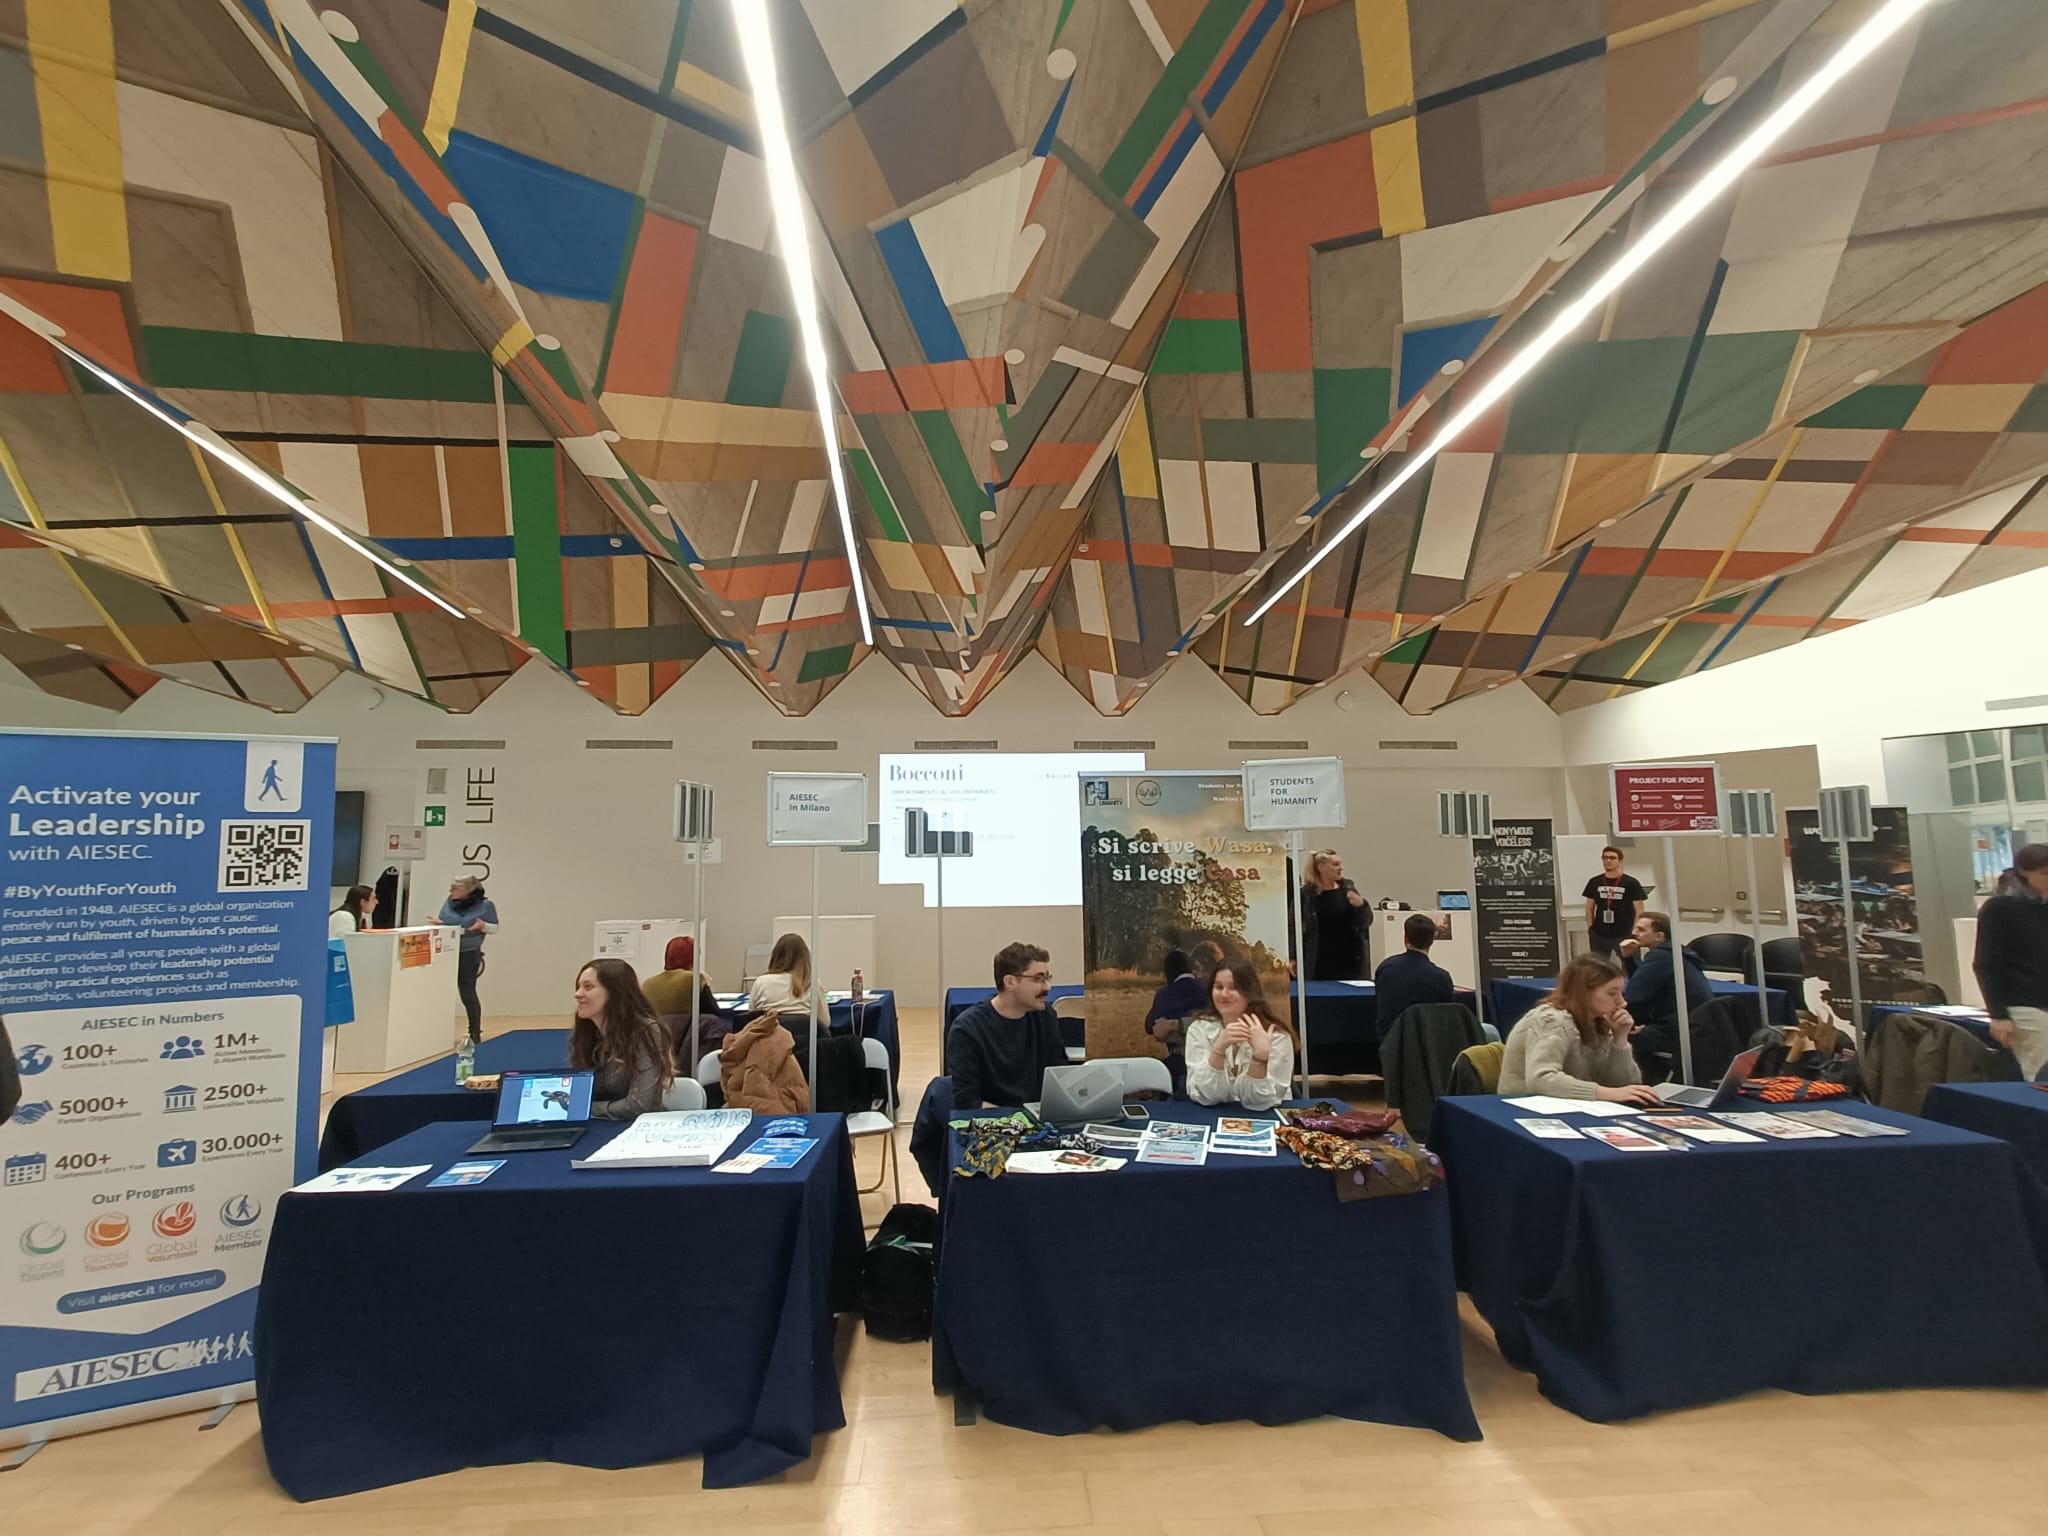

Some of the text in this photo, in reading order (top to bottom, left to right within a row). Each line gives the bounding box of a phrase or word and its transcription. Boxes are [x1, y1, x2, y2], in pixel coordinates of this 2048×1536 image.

[890, 764, 963, 781] Bocconi
[1270, 777, 1314, 786] STUDENTS
[9, 785, 201, 808] Activate your
[465, 767, 495, 823] LIFE
[1271, 797, 1318, 805] HUMANITY
[800, 803, 830, 812] Milano
[9, 812, 205, 839] Leadership
[8, 844, 153, 861] with AIESEC.
[1098, 837, 1122, 854] Si
[1128, 839, 1196, 854] scrive
[1111, 864, 1261, 885] si legge Casa
[4, 882, 177, 900] #ByYouthForYouth
[3, 907, 63, 918] Founded
[66, 907, 77, 916] in
[80, 905, 116, 915] 1948,
[119, 903, 166, 914] AIESEC
[168, 904, 177, 912] is
[189, 901, 224, 913] global
[226, 900, 294, 911] organization
[2, 920, 53, 931] entirely
[80, 919, 96, 929] by
[140, 916, 178, 926] driven
[180, 915, 196, 925] by
[197, 915, 220, 923] one
[222, 914, 259, 922] cause:
[1, 924, 280, 946] peace and fulfilment of humankind's potential.
[0, 952, 52, 964] AIESEC
[55, 951, 108, 963] provides
[111, 949, 125, 959] all
[128, 948, 165, 959] young
[168, 945, 207, 957] people
[211, 943, 236, 953] with
[247, 942, 280, 953] global
[0, 955, 274, 979] platform to develop their leadership potential
[55, 976, 109, 989] practical
[111, 971, 184, 985] experiences
[187, 970, 214, 980] such
[76, 985, 153, 999] volunteering
[156, 981, 203, 996] projects
[205, 981, 227, 991] and
[82, 1012, 224, 1030] AIESEC in Numbers
[213, 1032, 260, 1049] 1M+
[62, 1043, 118, 1061] 100+
[203, 1083, 268, 1102] 2500+
[59, 1096, 129, 1116] 5000+
[201, 1132, 284, 1154] 30.000+
[54, 1152, 111, 1170] 400+
[92, 1184, 195, 1205] Our Programs
[215, 1229, 263, 1243] AIESEC
[146, 1238, 198, 1255] Global
[214, 1240, 263, 1253] Member
[66, 1295, 98, 1308] Visit
[99, 1285, 155, 1304] aiesec.it
[158, 1281, 176, 1293] for
[39, 1346, 179, 1395] AIESEC
